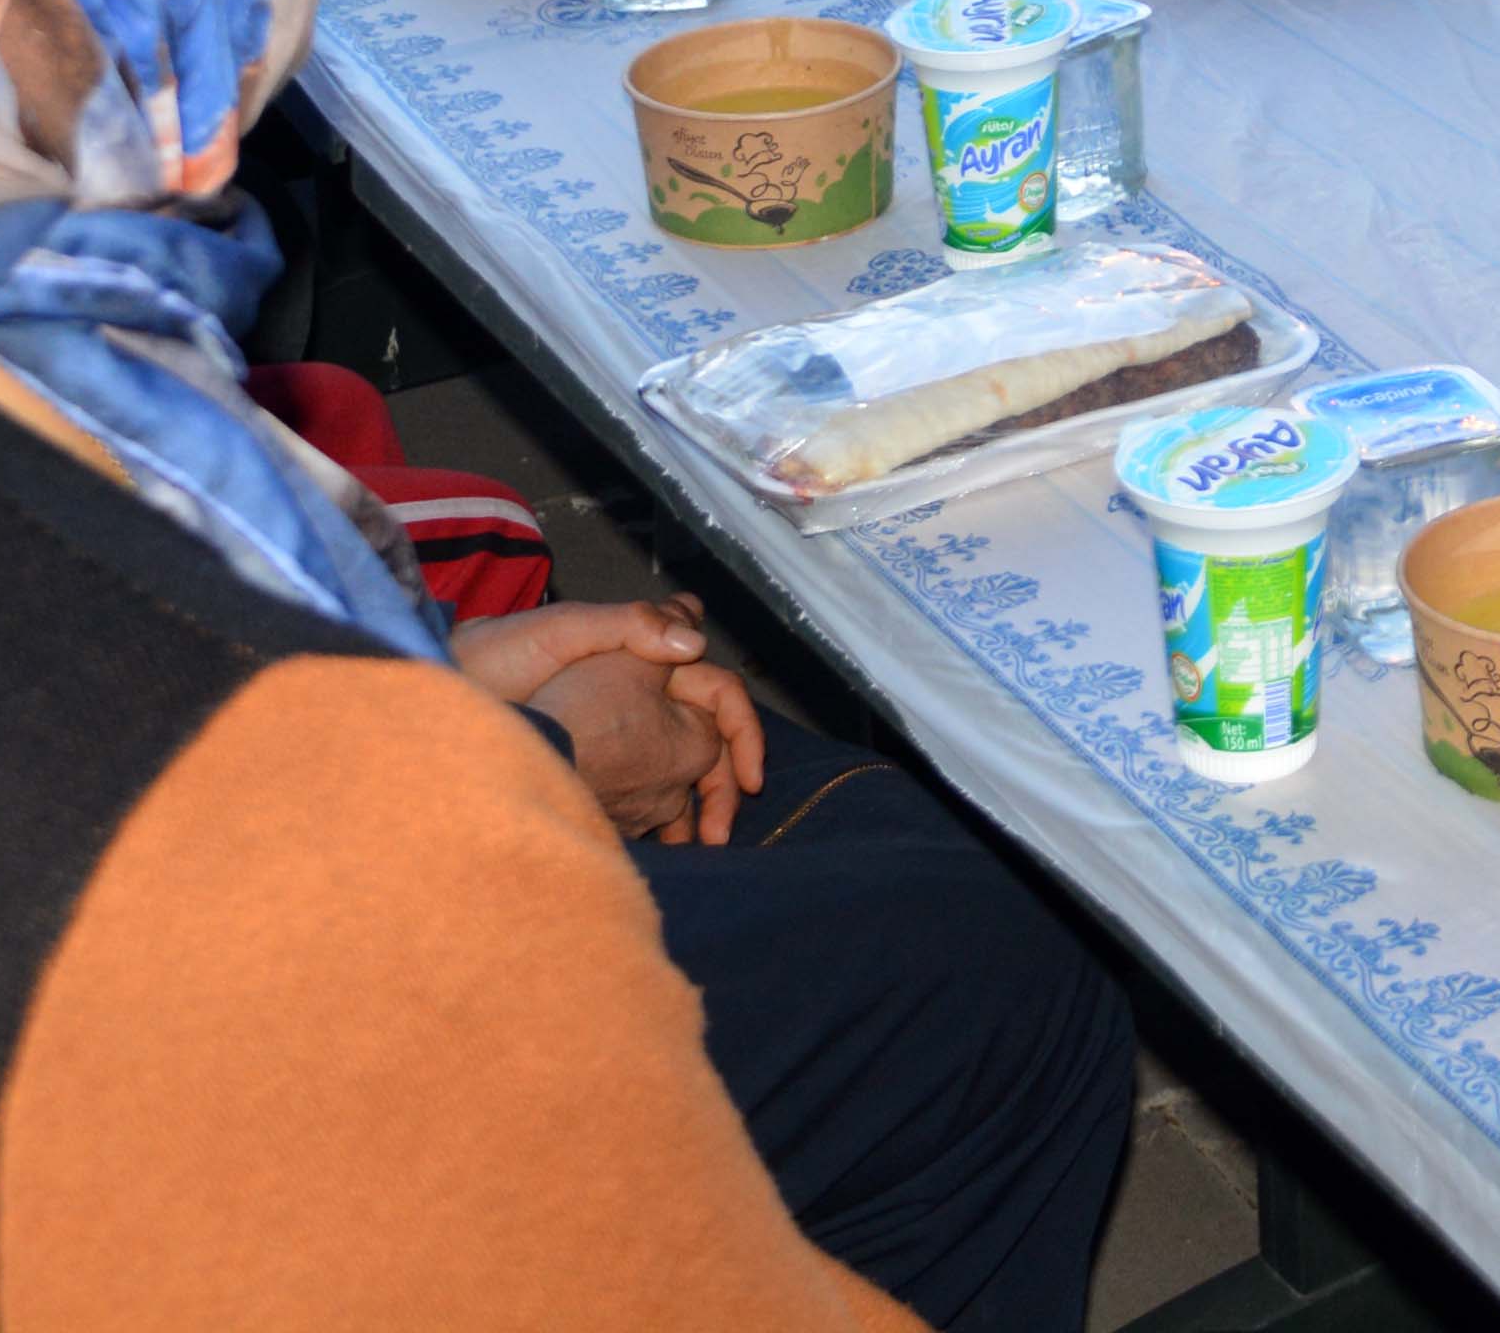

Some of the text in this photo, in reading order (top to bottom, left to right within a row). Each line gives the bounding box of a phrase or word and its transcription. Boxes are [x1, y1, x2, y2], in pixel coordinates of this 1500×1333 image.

[960, 119, 1043, 177] Ayran
[1176, 418, 1302, 493] Ayran
[1222, 721, 1247, 736] Net:
[1223, 736, 1264, 750] 150 ml
